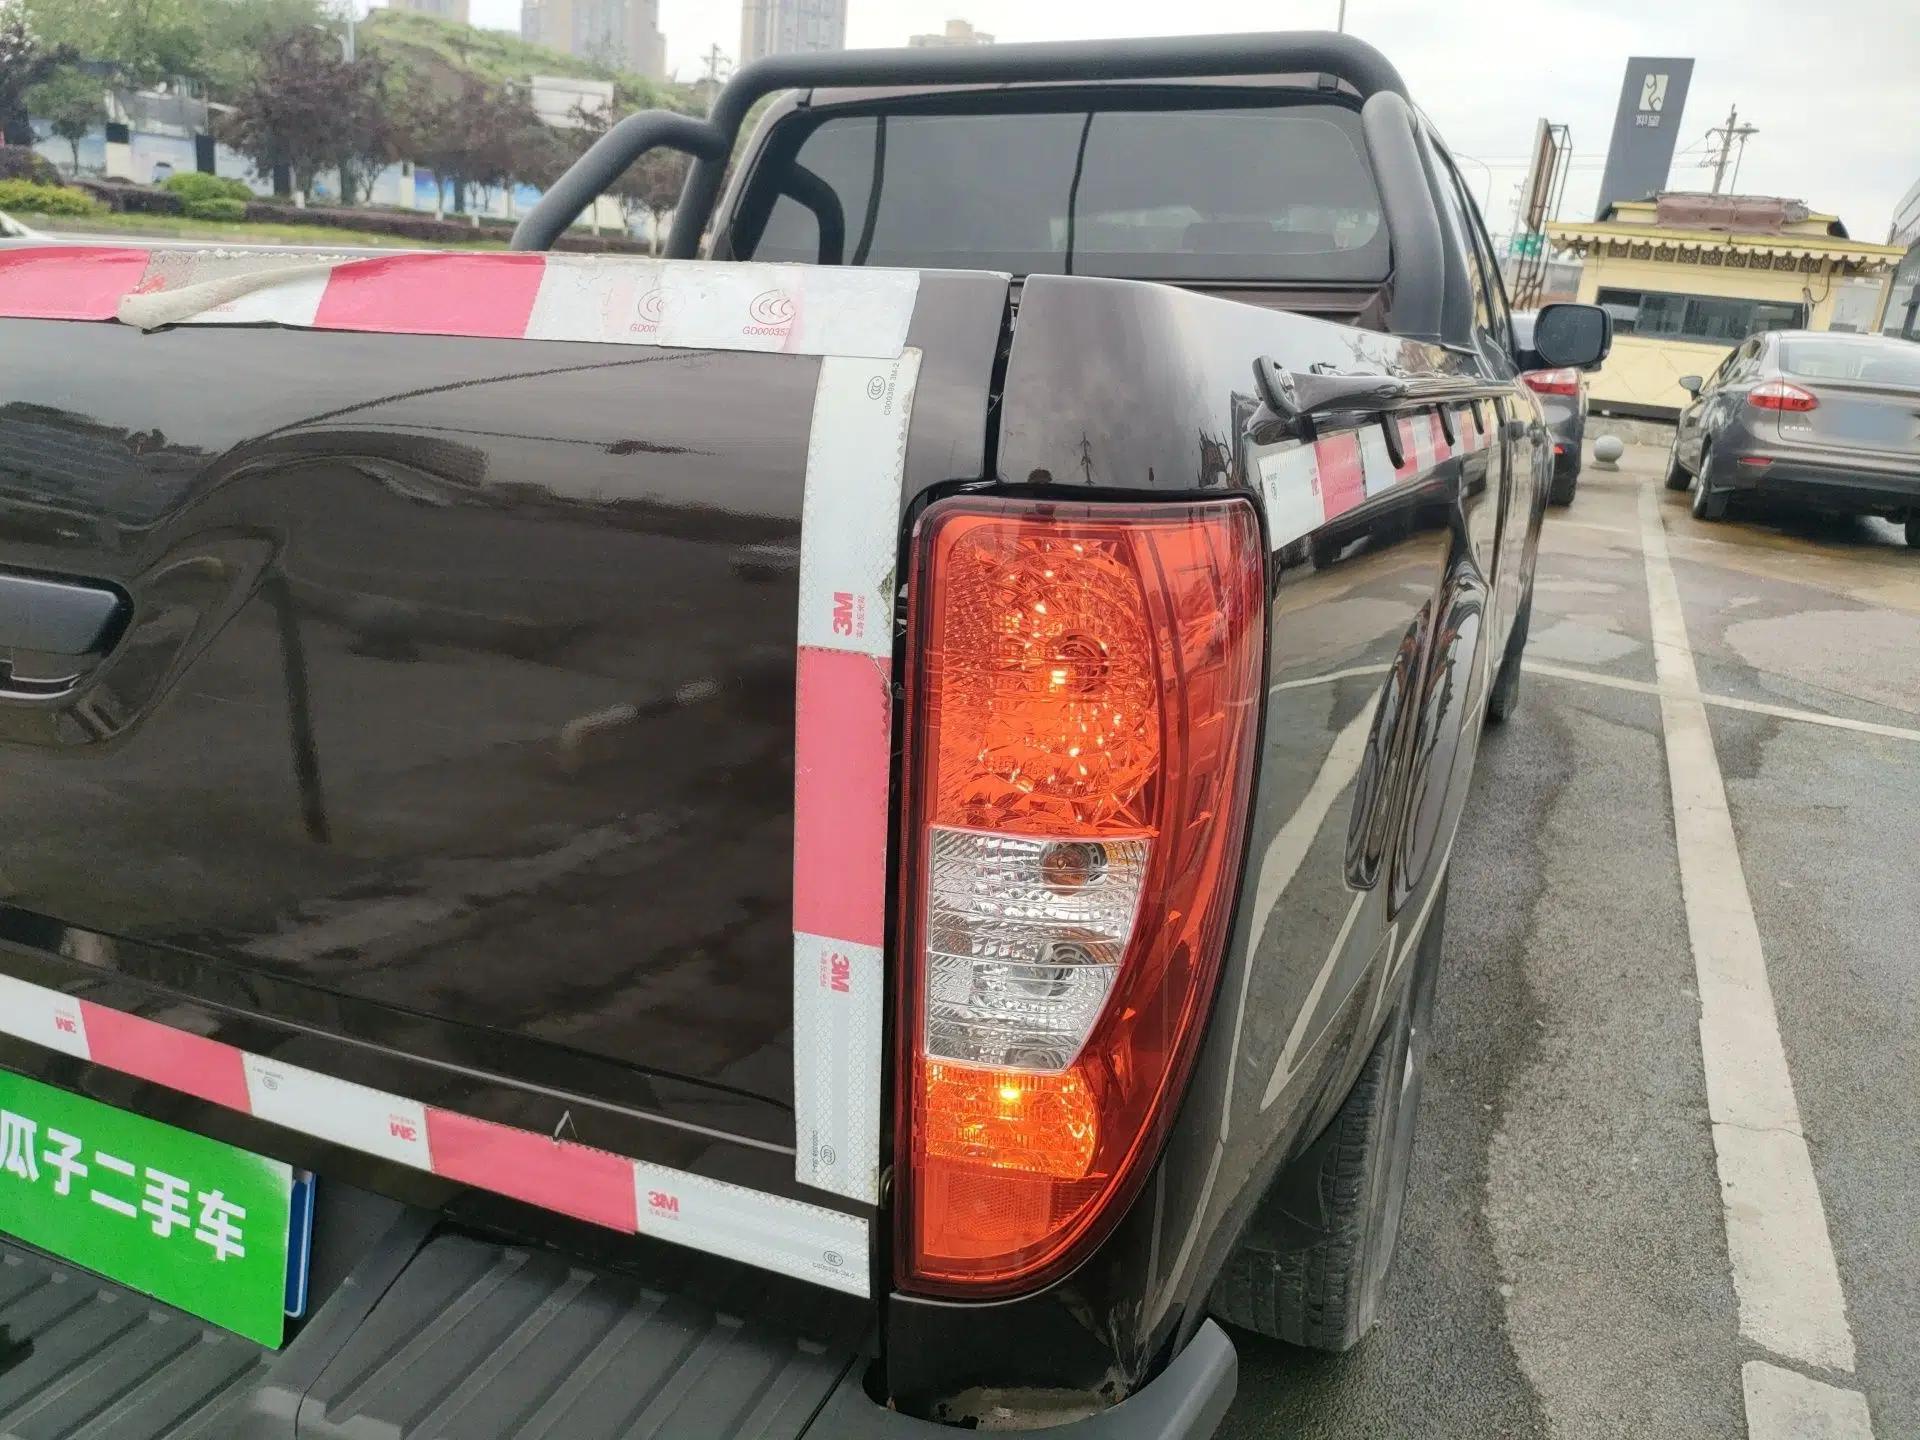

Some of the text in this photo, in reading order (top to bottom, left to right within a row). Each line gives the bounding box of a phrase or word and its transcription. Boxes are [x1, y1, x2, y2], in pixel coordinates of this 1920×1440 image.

[833, 591, 853, 637] 3M
[831, 952, 849, 993] 3M
[390, 1122, 417, 1142] 3M
[0, 1109, 246, 1262] 瓜子二手车
[648, 1191, 680, 1213] 3M
